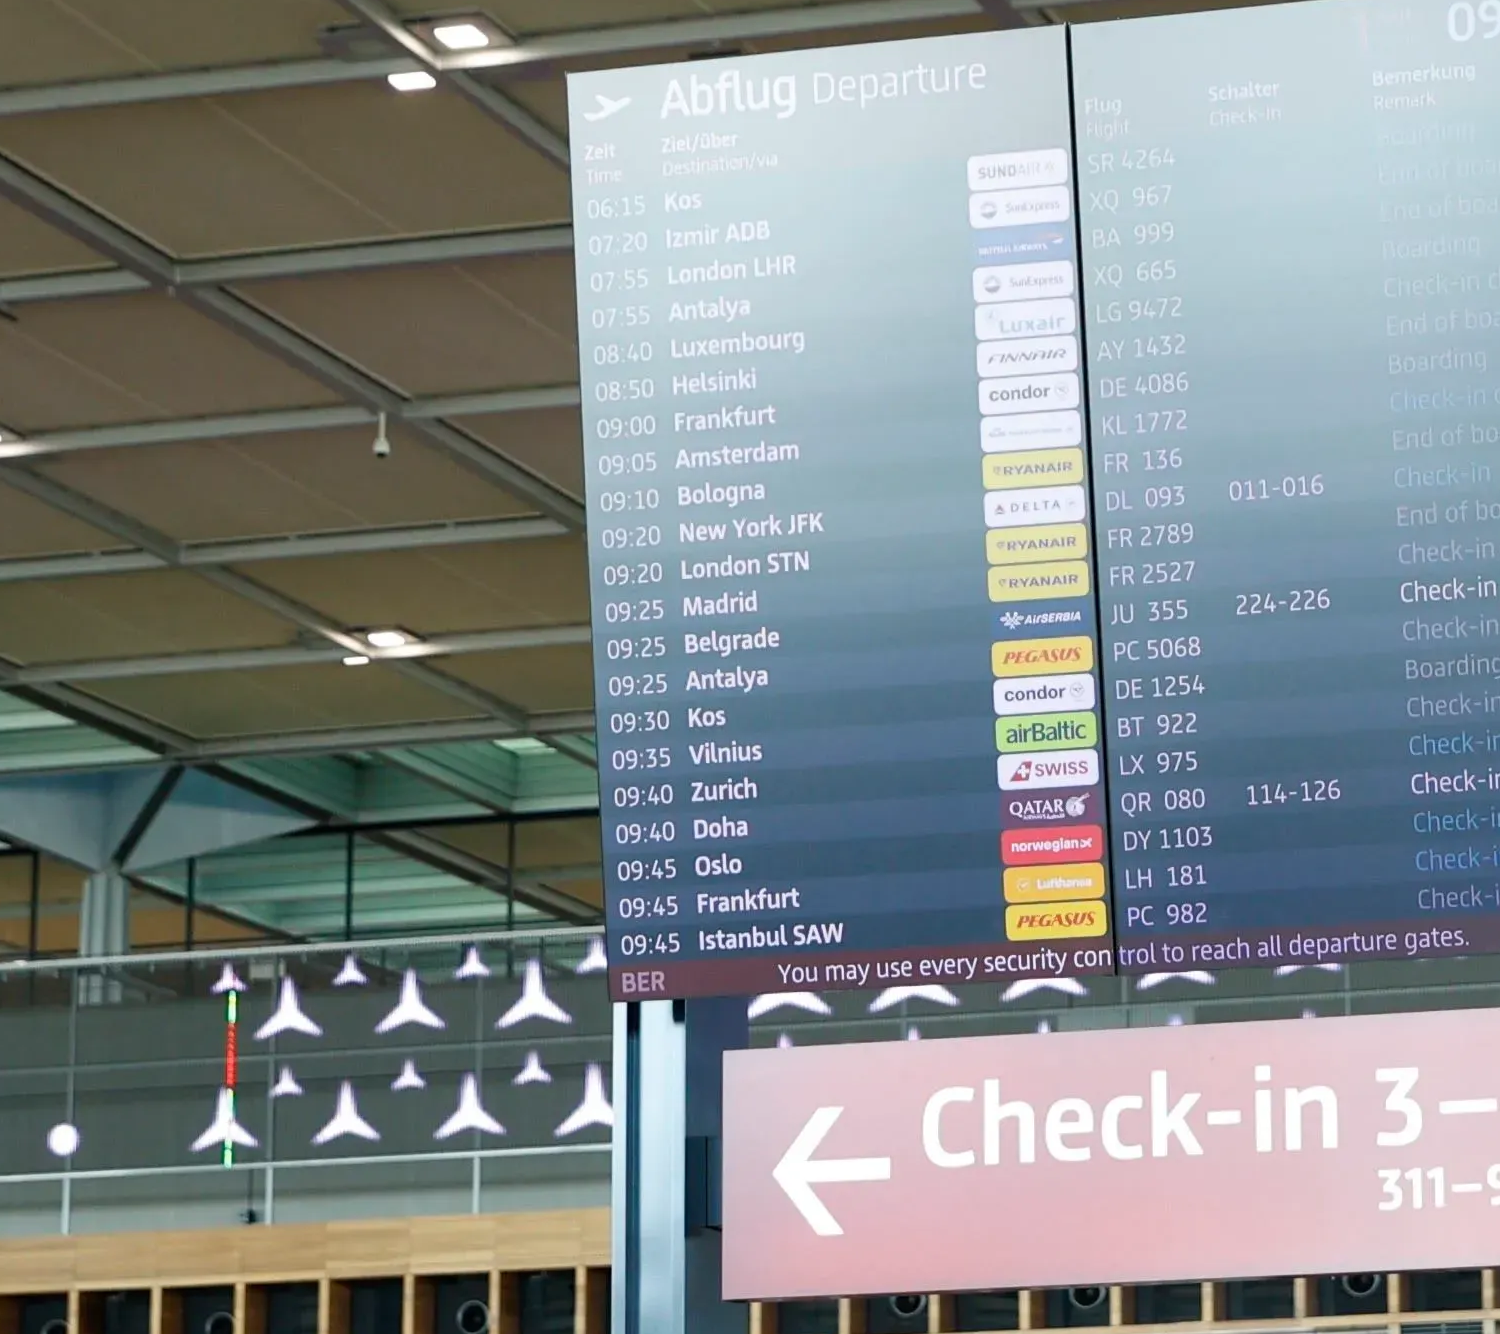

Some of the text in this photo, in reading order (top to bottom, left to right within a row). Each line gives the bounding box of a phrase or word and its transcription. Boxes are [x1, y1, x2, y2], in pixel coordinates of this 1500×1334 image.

[659, 62, 987, 120] Abflug Departure
[593, 330, 806, 366] 08:40 Luxembourg
[988, 384, 1051, 402] condor
[1006, 536, 1077, 551] RYANAIR
[1005, 719, 1087, 744] airBaltic
[1034, 760, 1089, 778] SWISS
[613, 776, 758, 808] 09:40 Zurich
[1120, 791, 1152, 818] QR
[1164, 787, 1206, 811] 080
[1246, 778, 1341, 806] 114-126
[1011, 836, 1080, 853] norwegian
[1017, 911, 1095, 930] PEGASUS
[620, 922, 844, 956] 09:45 Istanbul SAW
[621, 970, 665, 994] BER
[777, 963, 818, 984] You
[825, 962, 871, 986] may
[876, 960, 913, 979] use
[919, 956, 978, 980] every
[983, 948, 1068, 975] security
[1163, 944, 1184, 962] to
[1191, 936, 1250, 962] reach
[1257, 934, 1284, 958] all
[1288, 931, 1398, 961] departure
[1404, 927, 1472, 956] gates.
[922, 1064, 1339, 1168] Check-in
